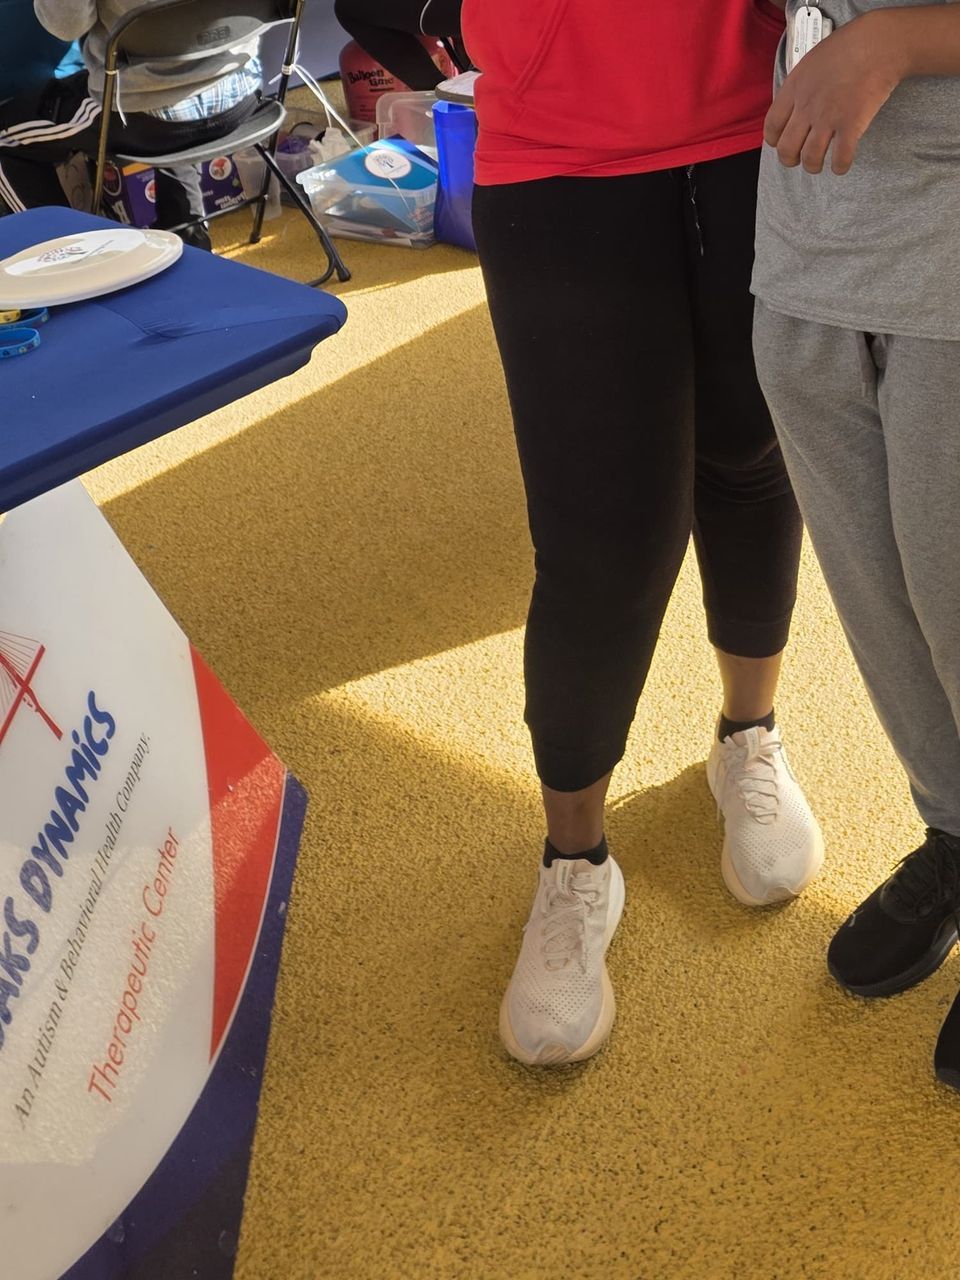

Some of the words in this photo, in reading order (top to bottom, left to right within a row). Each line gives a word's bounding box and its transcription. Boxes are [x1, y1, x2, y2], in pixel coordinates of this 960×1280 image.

[95, 812, 123, 875] Health
[59, 868, 103, 983] Behavioral
[87, 921, 157, 1104] Therapeutic
[142, 826, 180, 917] Center
[0, 896, 40, 1050] AKS
[54, 978, 69, 1002] &
[27, 1000, 64, 1089] Autism
[13, 1087, 36, 1129] An
